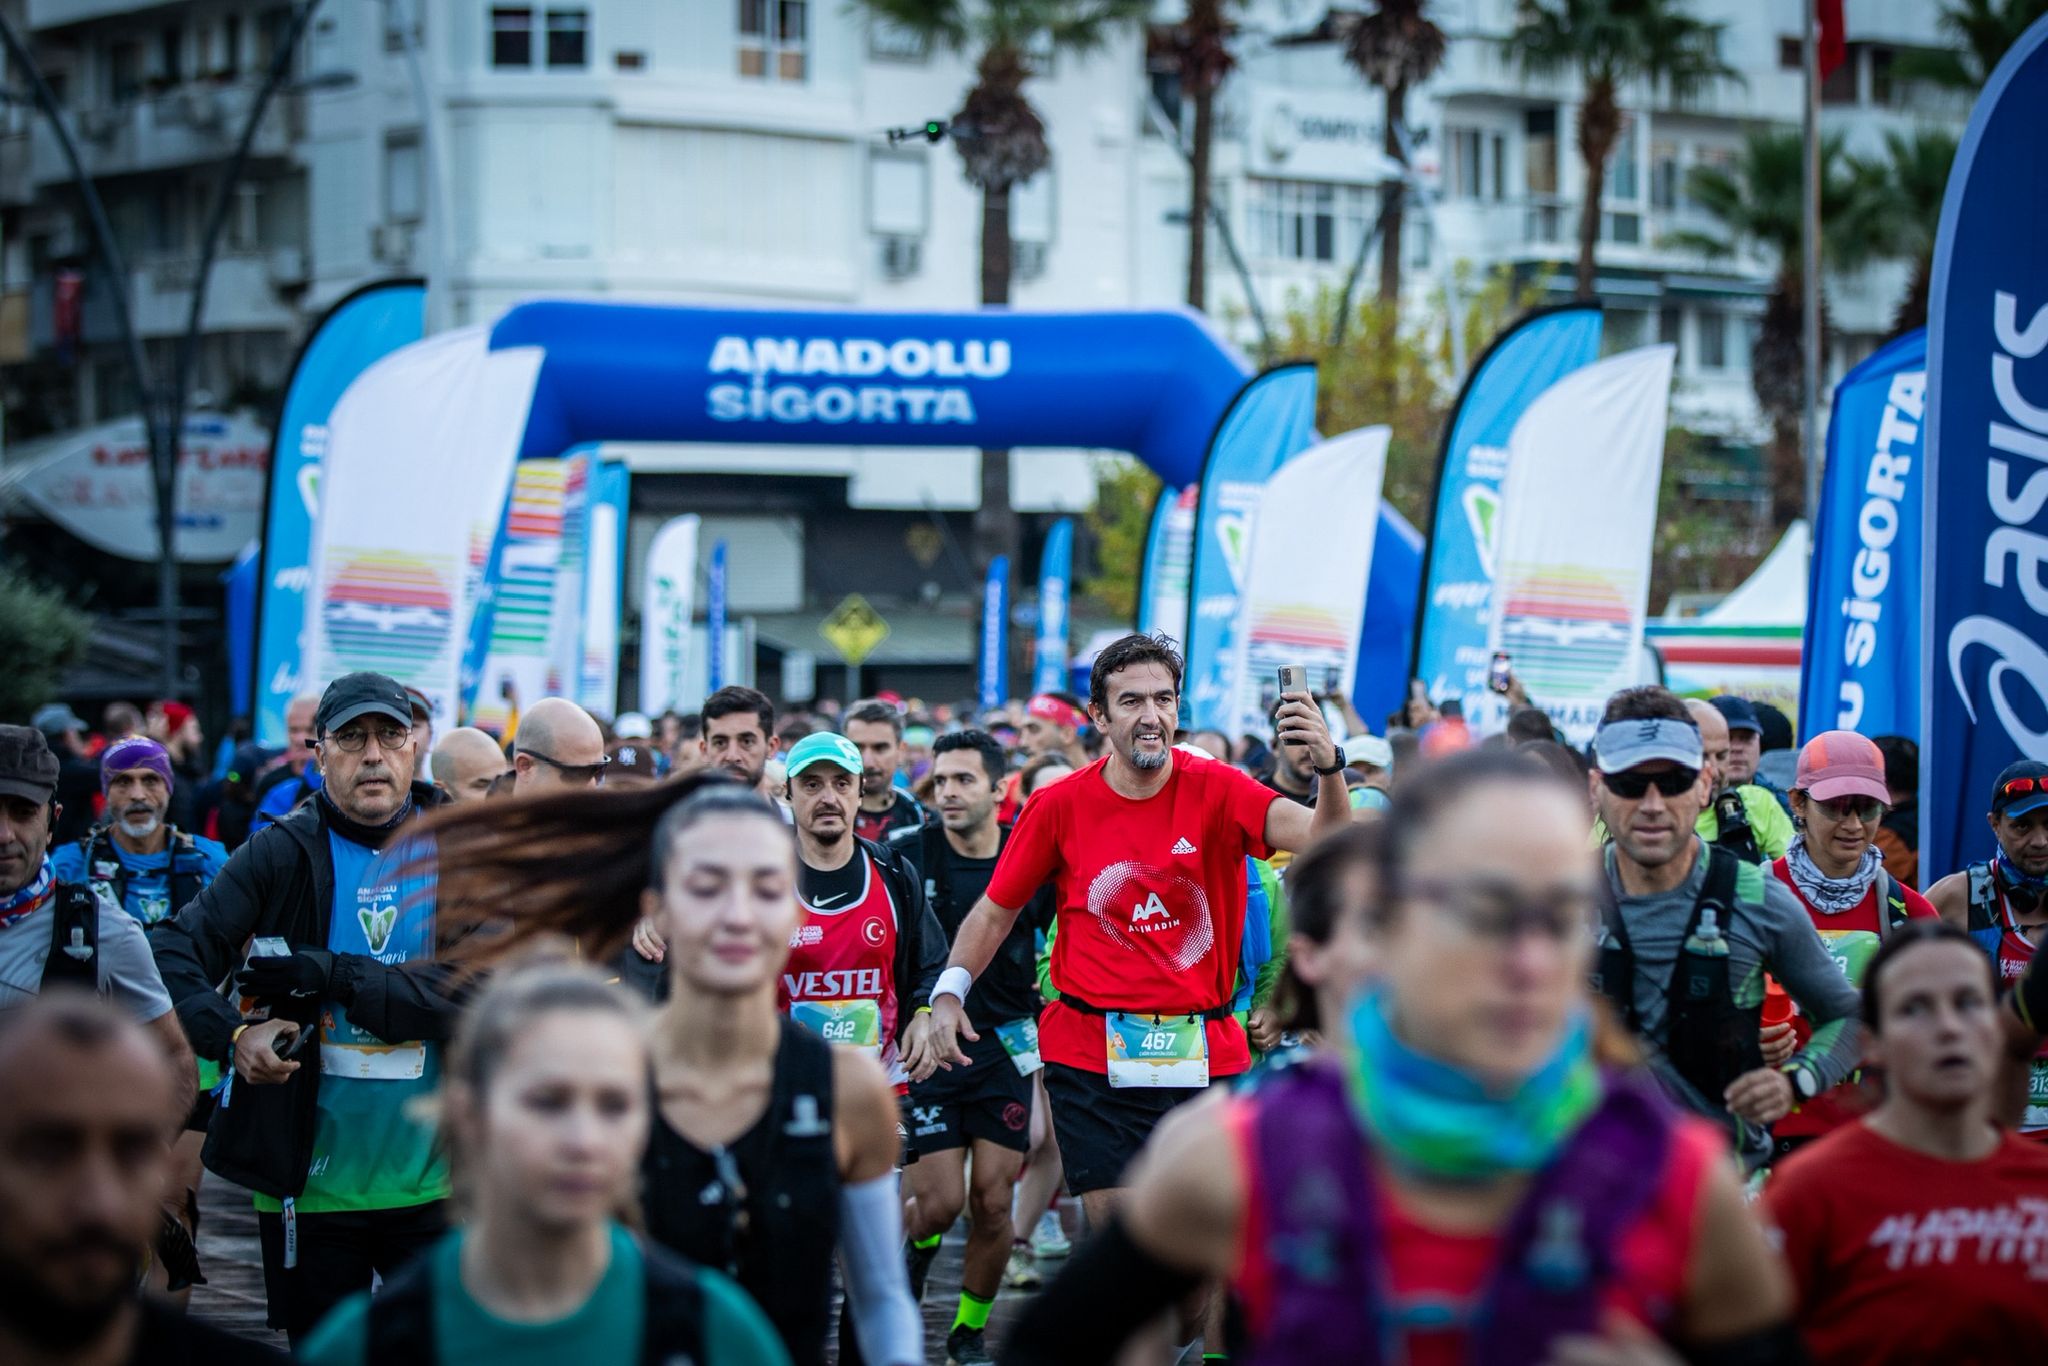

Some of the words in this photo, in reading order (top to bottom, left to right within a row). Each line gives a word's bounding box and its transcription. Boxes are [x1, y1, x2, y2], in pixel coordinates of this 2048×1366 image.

[708, 336, 1011, 377] ANADOLU
[707, 373, 977, 423] SİGORTA
[1171, 846, 1197, 855] adidas
[783, 968, 884, 997] VESTEL
[822, 1020, 856, 1039] 642
[1141, 1032, 1177, 1050] 467
